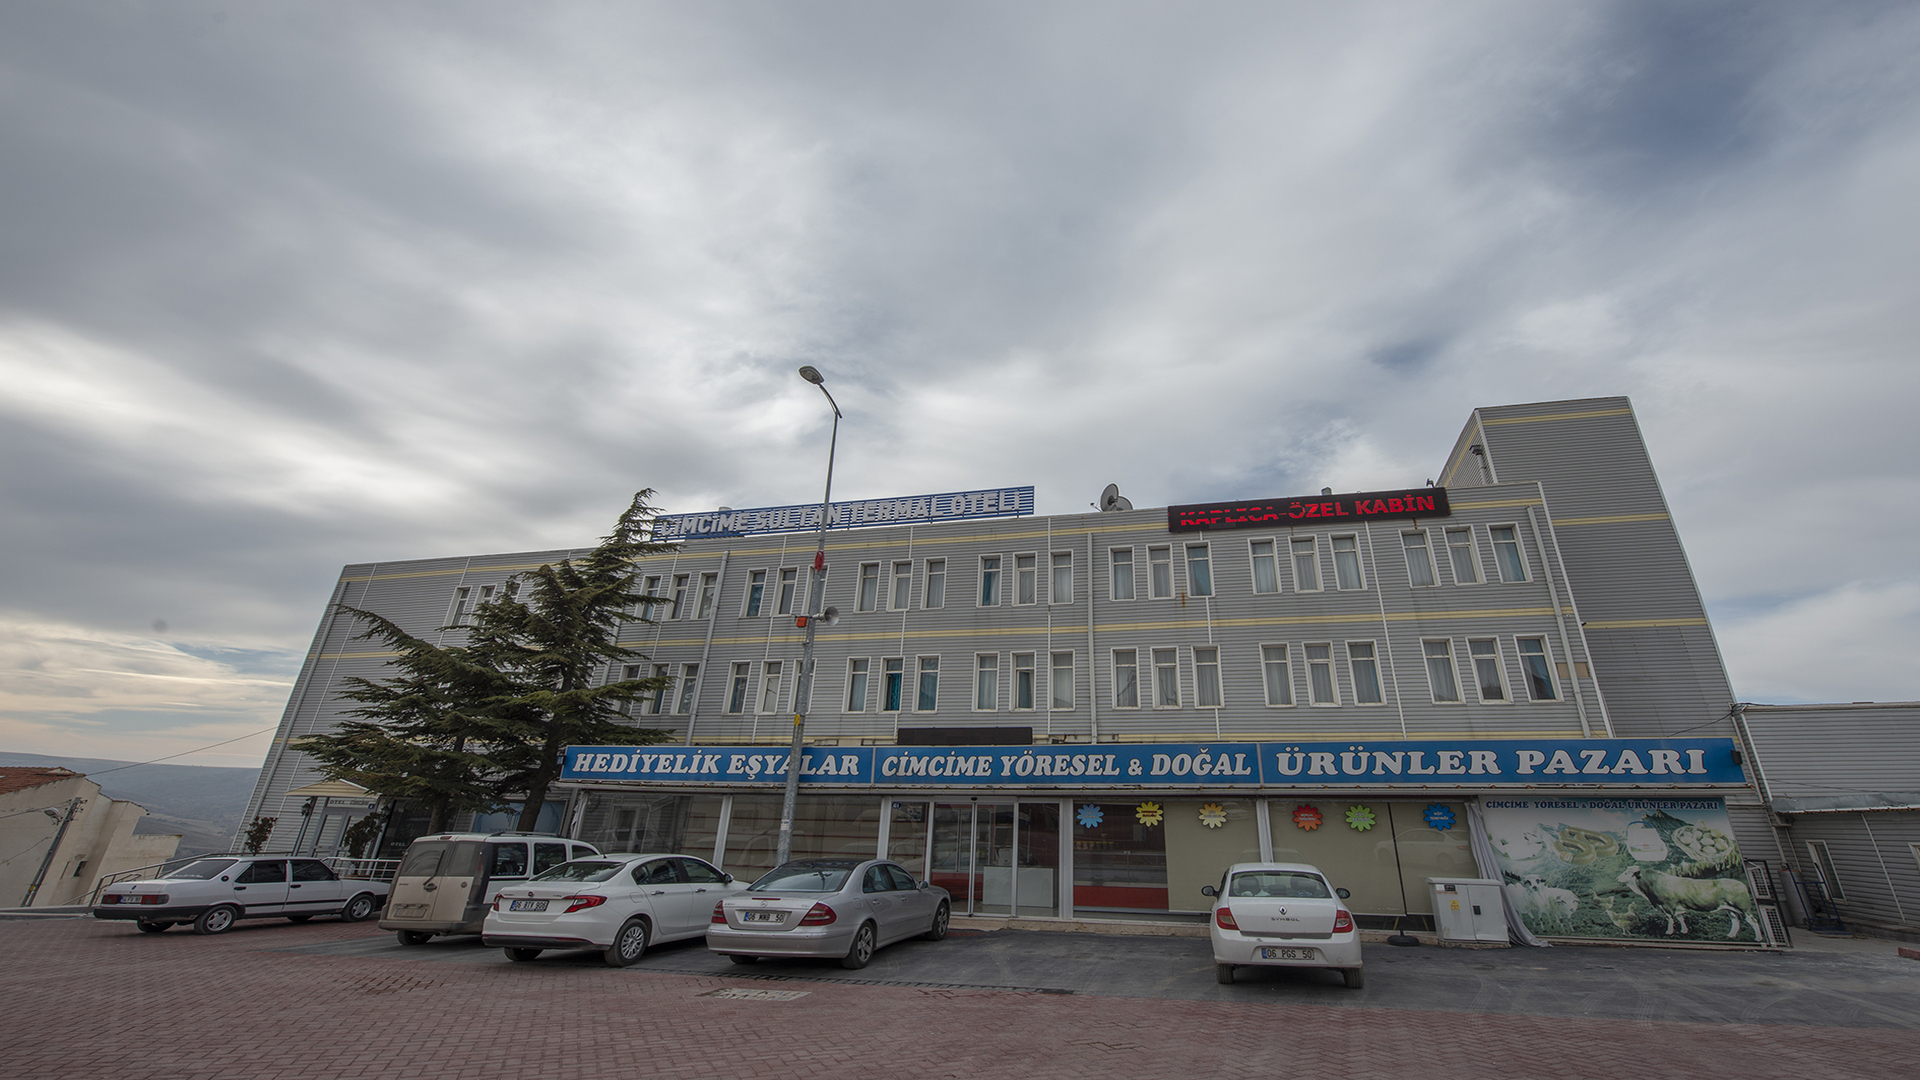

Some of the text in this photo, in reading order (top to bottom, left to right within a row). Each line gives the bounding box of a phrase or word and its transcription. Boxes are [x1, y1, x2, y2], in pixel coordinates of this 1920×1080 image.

[754, 505, 843, 529] SULTAN
[850, 497, 944, 523] TERMAL
[951, 491, 1020, 515] OTELİ
[1355, 494, 1435, 515] KABİN
[572, 749, 859, 780] HEDİYELİK EŞYALAR
[881, 748, 1252, 776] CİMCİME YÖRESEL & DOĞAL
[1275, 746, 1707, 775] ÜRÜNLER PAZARI
[1486, 800, 1529, 809] CİMCİME
[1534, 800, 1579, 809] YÖRESEL
[1589, 799, 1625, 809] DOĞAL
[1627, 800, 1676, 810] ÜRÜNLER
[1679, 801, 1719, 810] PAZARI
[1266, 948, 1312, 959] 06 PGS 50
